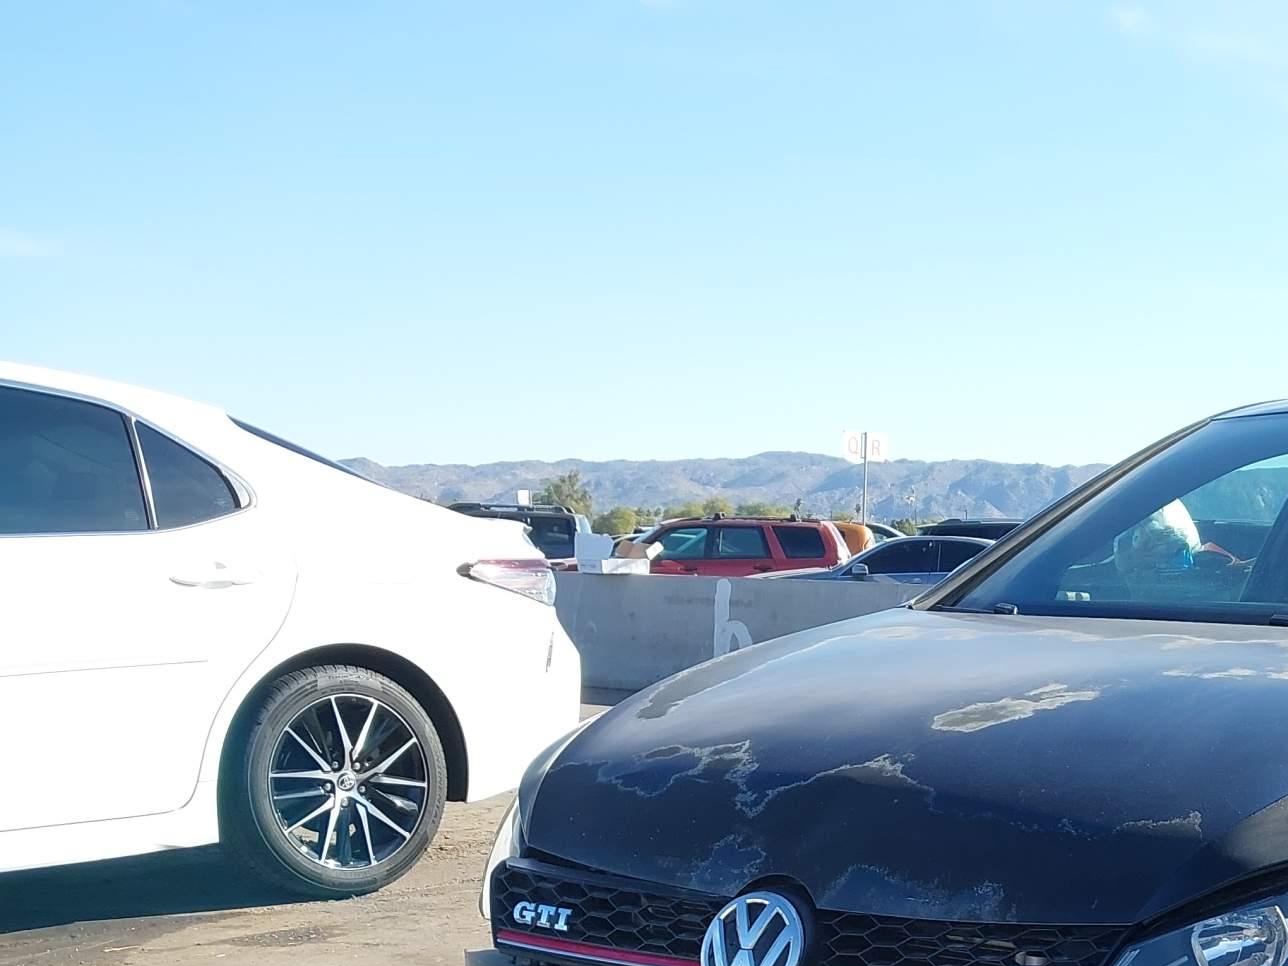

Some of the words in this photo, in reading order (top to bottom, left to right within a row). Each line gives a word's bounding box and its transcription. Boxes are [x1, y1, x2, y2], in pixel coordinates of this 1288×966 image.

[848, 436, 860, 455] Q
[871, 439, 881, 456] R
[513, 901, 574, 931] GTI
